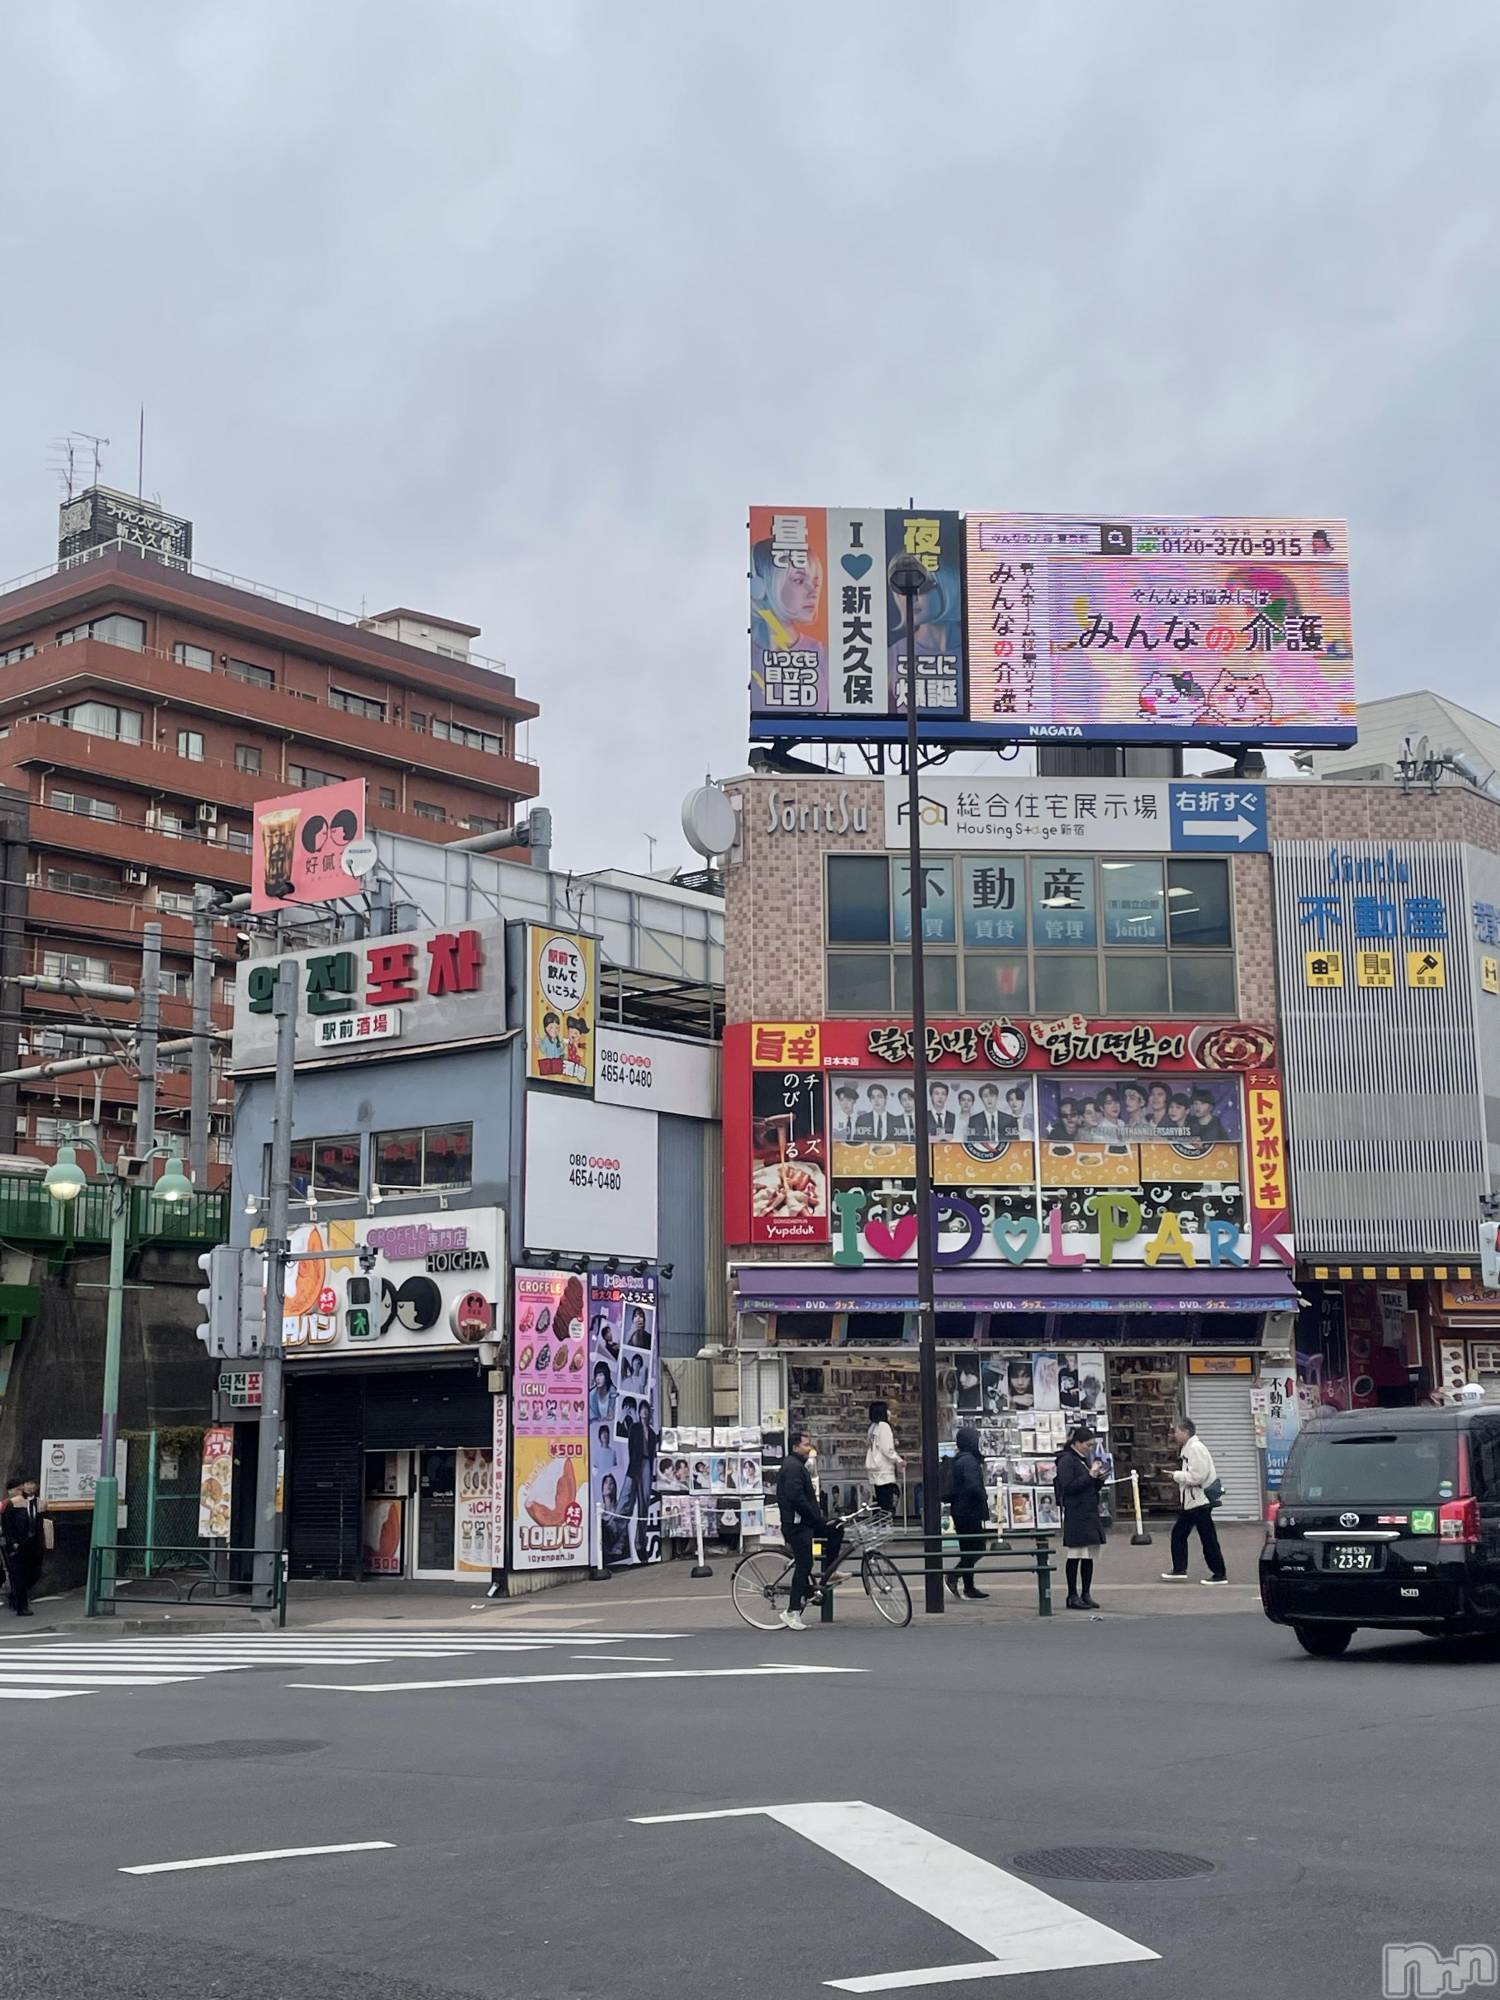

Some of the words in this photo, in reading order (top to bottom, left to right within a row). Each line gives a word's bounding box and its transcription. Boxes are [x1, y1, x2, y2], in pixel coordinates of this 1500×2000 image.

[117, 522, 172, 552] 新大久保
[771, 515, 808, 549] 昼
[849, 522, 864, 548] I
[903, 518, 941, 554] 夜
[1163, 537, 1302, 557] 0120-370-915
[771, 550, 808, 569] でも
[1131, 588, 1272, 607] そんなお悩みには
[989, 562, 1018, 713] みんなの介護
[1078, 612, 1324, 652] みんなの介護
[842, 586, 873, 705] 新大久保
[763, 650, 818, 668] いつでも
[765, 668, 818, 684] 目立つ
[765, 684, 818, 706] LED
[1029, 726, 1083, 738] NAGATA
[956, 792, 1159, 819] 総合住宅展示場
[1176, 790, 1258, 812] 右折すぐ
[956, 823, 1013, 839] Housing
[1015, 823, 1058, 839] Stage
[1061, 824, 1085, 836] 新宿
[901, 866, 1086, 911] 不動産
[1298, 895, 1448, 940] 不動産
[975, 919, 1016, 939] 賃貸
[1045, 919, 1085, 939] 管理
[547, 948, 579, 967] 駅前で
[547, 965, 579, 983] 飲んで
[321, 1013, 388, 1041] 駅前酒場
[1032, 1015, 1084, 1039] 동대문
[600, 1049, 619, 1063] 080
[755, 1027, 817, 1065] 旨辛
[1045, 1025, 1185, 1068] 엽기떡볶이
[823, 1056, 860, 1066] 日本本店
[600, 1064, 653, 1088] 4654-0480
[1248, 1073, 1278, 1086] チーズ
[569, 1153, 588, 1167] 080
[1255, 1091, 1283, 1207] トッポッキ
[569, 1168, 621, 1191] 4654-0480
[368, 1226, 427, 1247] CROFFLE
[428, 1230, 466, 1249] 専門店
[766, 1225, 815, 1239] Yupdduk
[426, 1250, 489, 1273] HOICHA
[519, 1280, 562, 1294] CROFFLE
[522, 1383, 547, 1397] ICHU
[1270, 1378, 1283, 1419] 不動産
[550, 1443, 584, 1457] ¥500
[520, 1526, 583, 1551] 10円パン
[528, 1552, 576, 1563] 10yenpan.jp
[1338, 1554, 1372, 1569] 23-97
[1400, 1587, 1420, 1597] km
